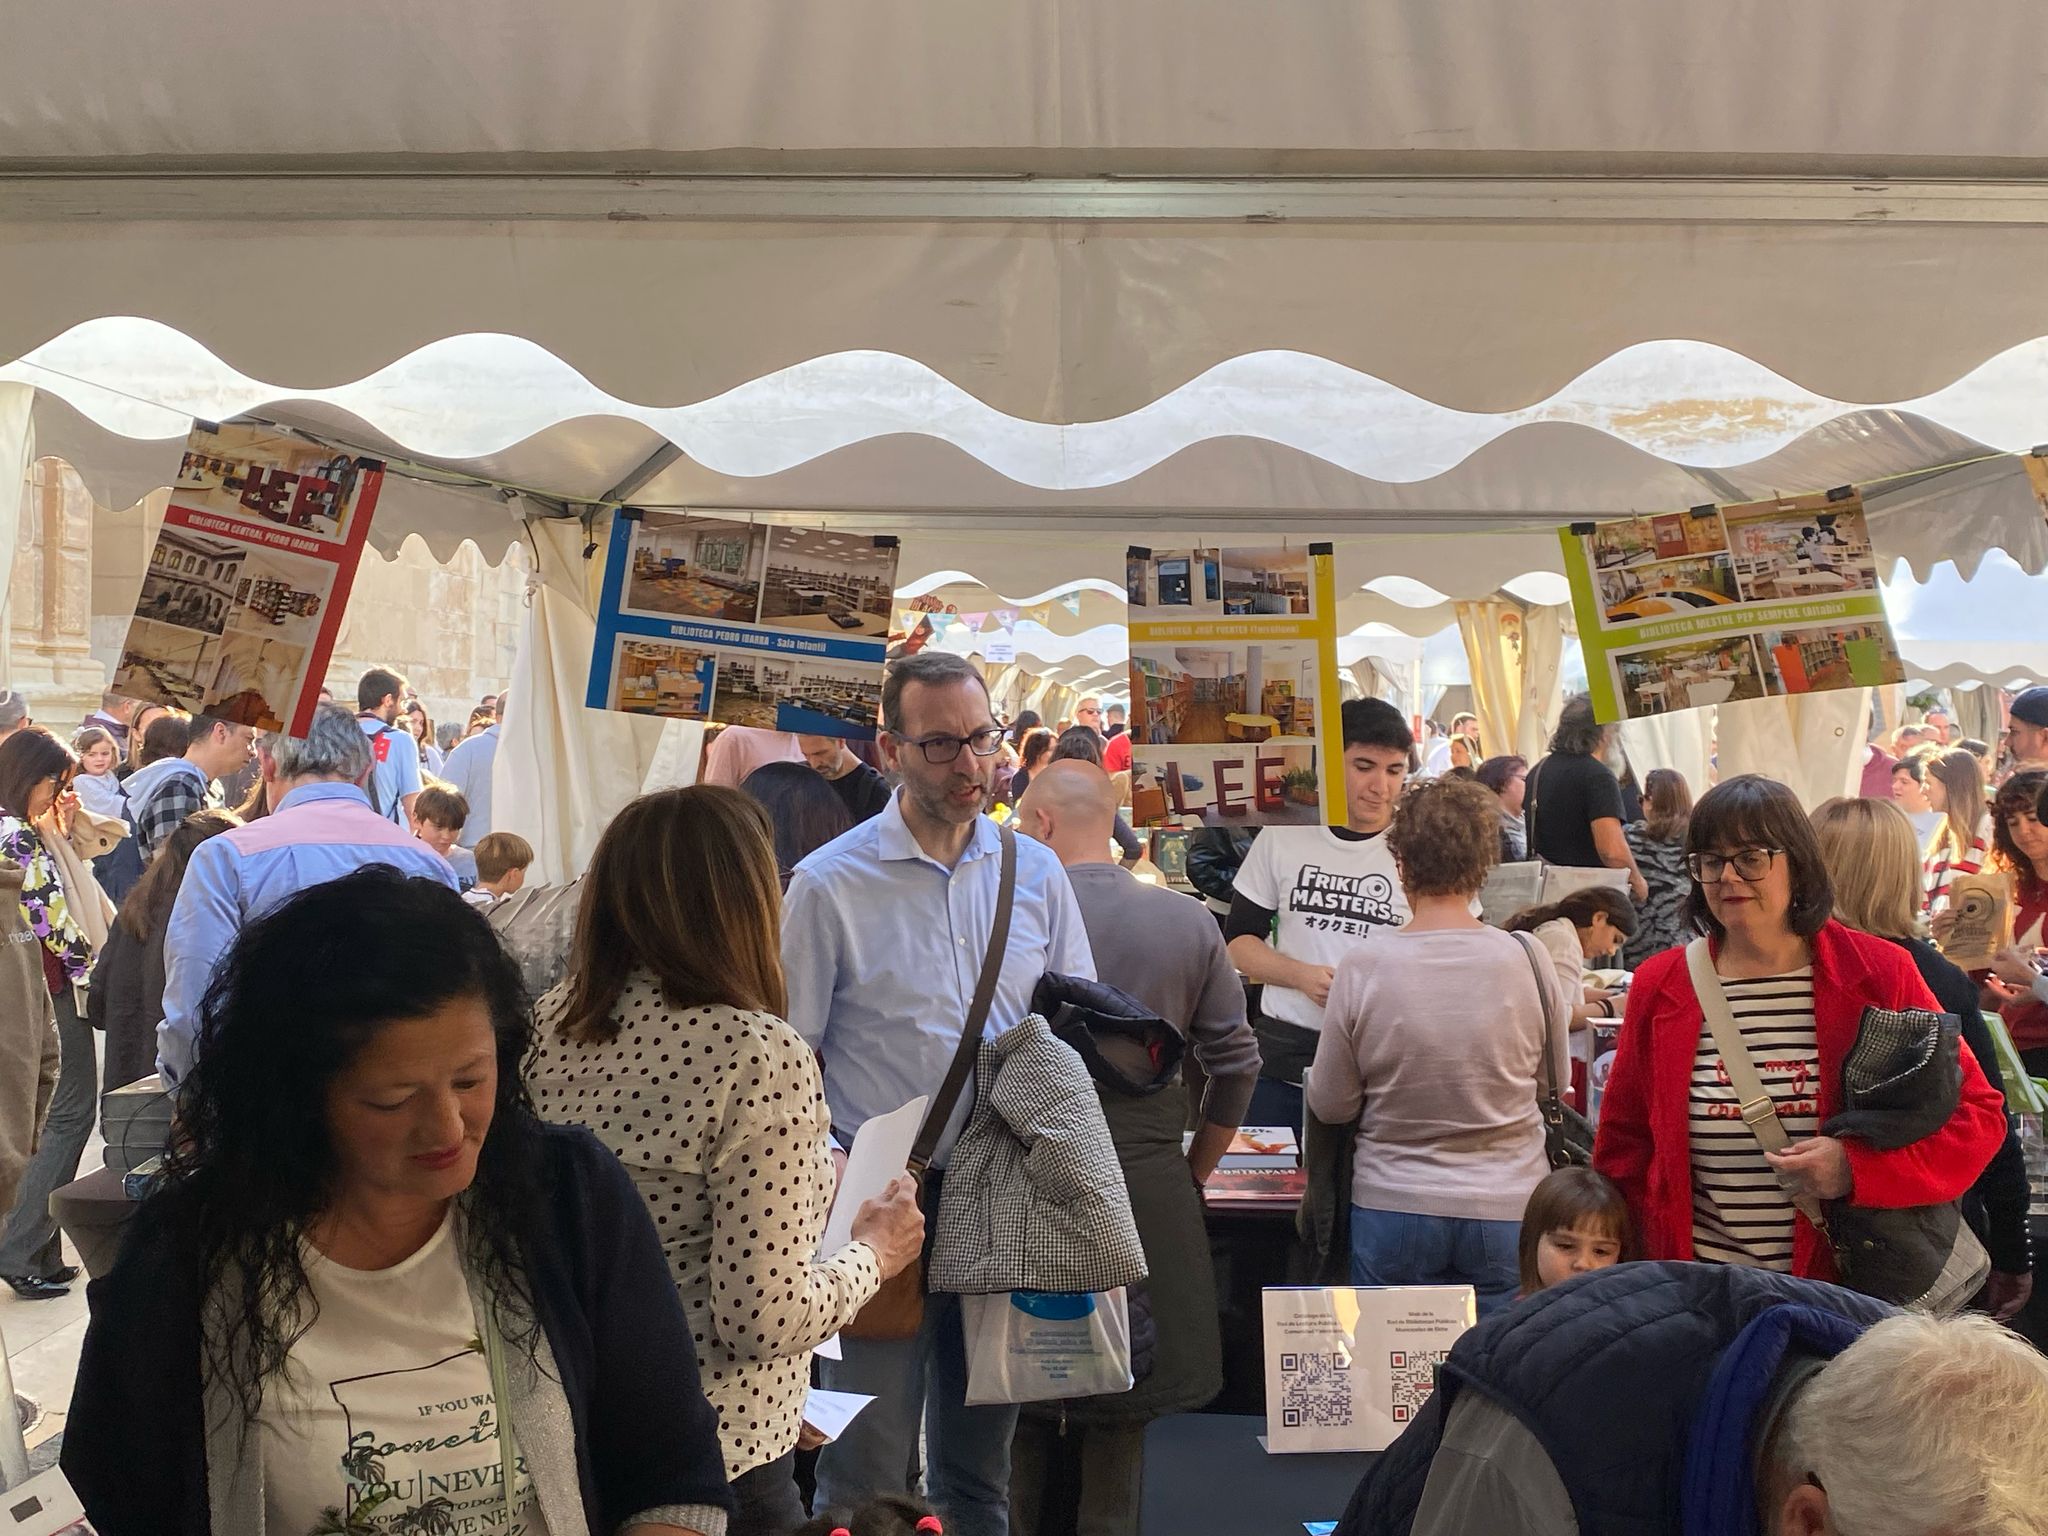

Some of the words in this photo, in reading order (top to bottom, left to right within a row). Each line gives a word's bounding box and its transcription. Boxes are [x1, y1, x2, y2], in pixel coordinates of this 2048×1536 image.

[187, 513, 230, 532] BIBLIOTECA
[230, 524, 264, 540] CENTRAL
[1639, 622, 1695, 640] BIBLIOTECA
[1696, 614, 1735, 629] MESTRE
[1737, 612, 1755, 624] PEP
[1757, 607, 1801, 621] SEMPERE
[670, 624, 714, 639] BIBLIOTECA
[715, 630, 739, 642] PEDRO
[741, 633, 770, 646] IBARRA
[776, 637, 795, 649] Sala
[796, 639, 827, 652] Infantil
[1166, 757, 1285, 817] LEE
[1299, 865, 1360, 895] FRIKI
[1305, 915, 1370, 939] オタク王!!
[1214, 1168, 1297, 1176] CONTRAPASO
[417, 1406, 433, 1417] IF
[435, 1399, 468, 1413] YOU
[470, 1394, 496, 1406] WA
[350, 1478, 415, 1504] YOU
